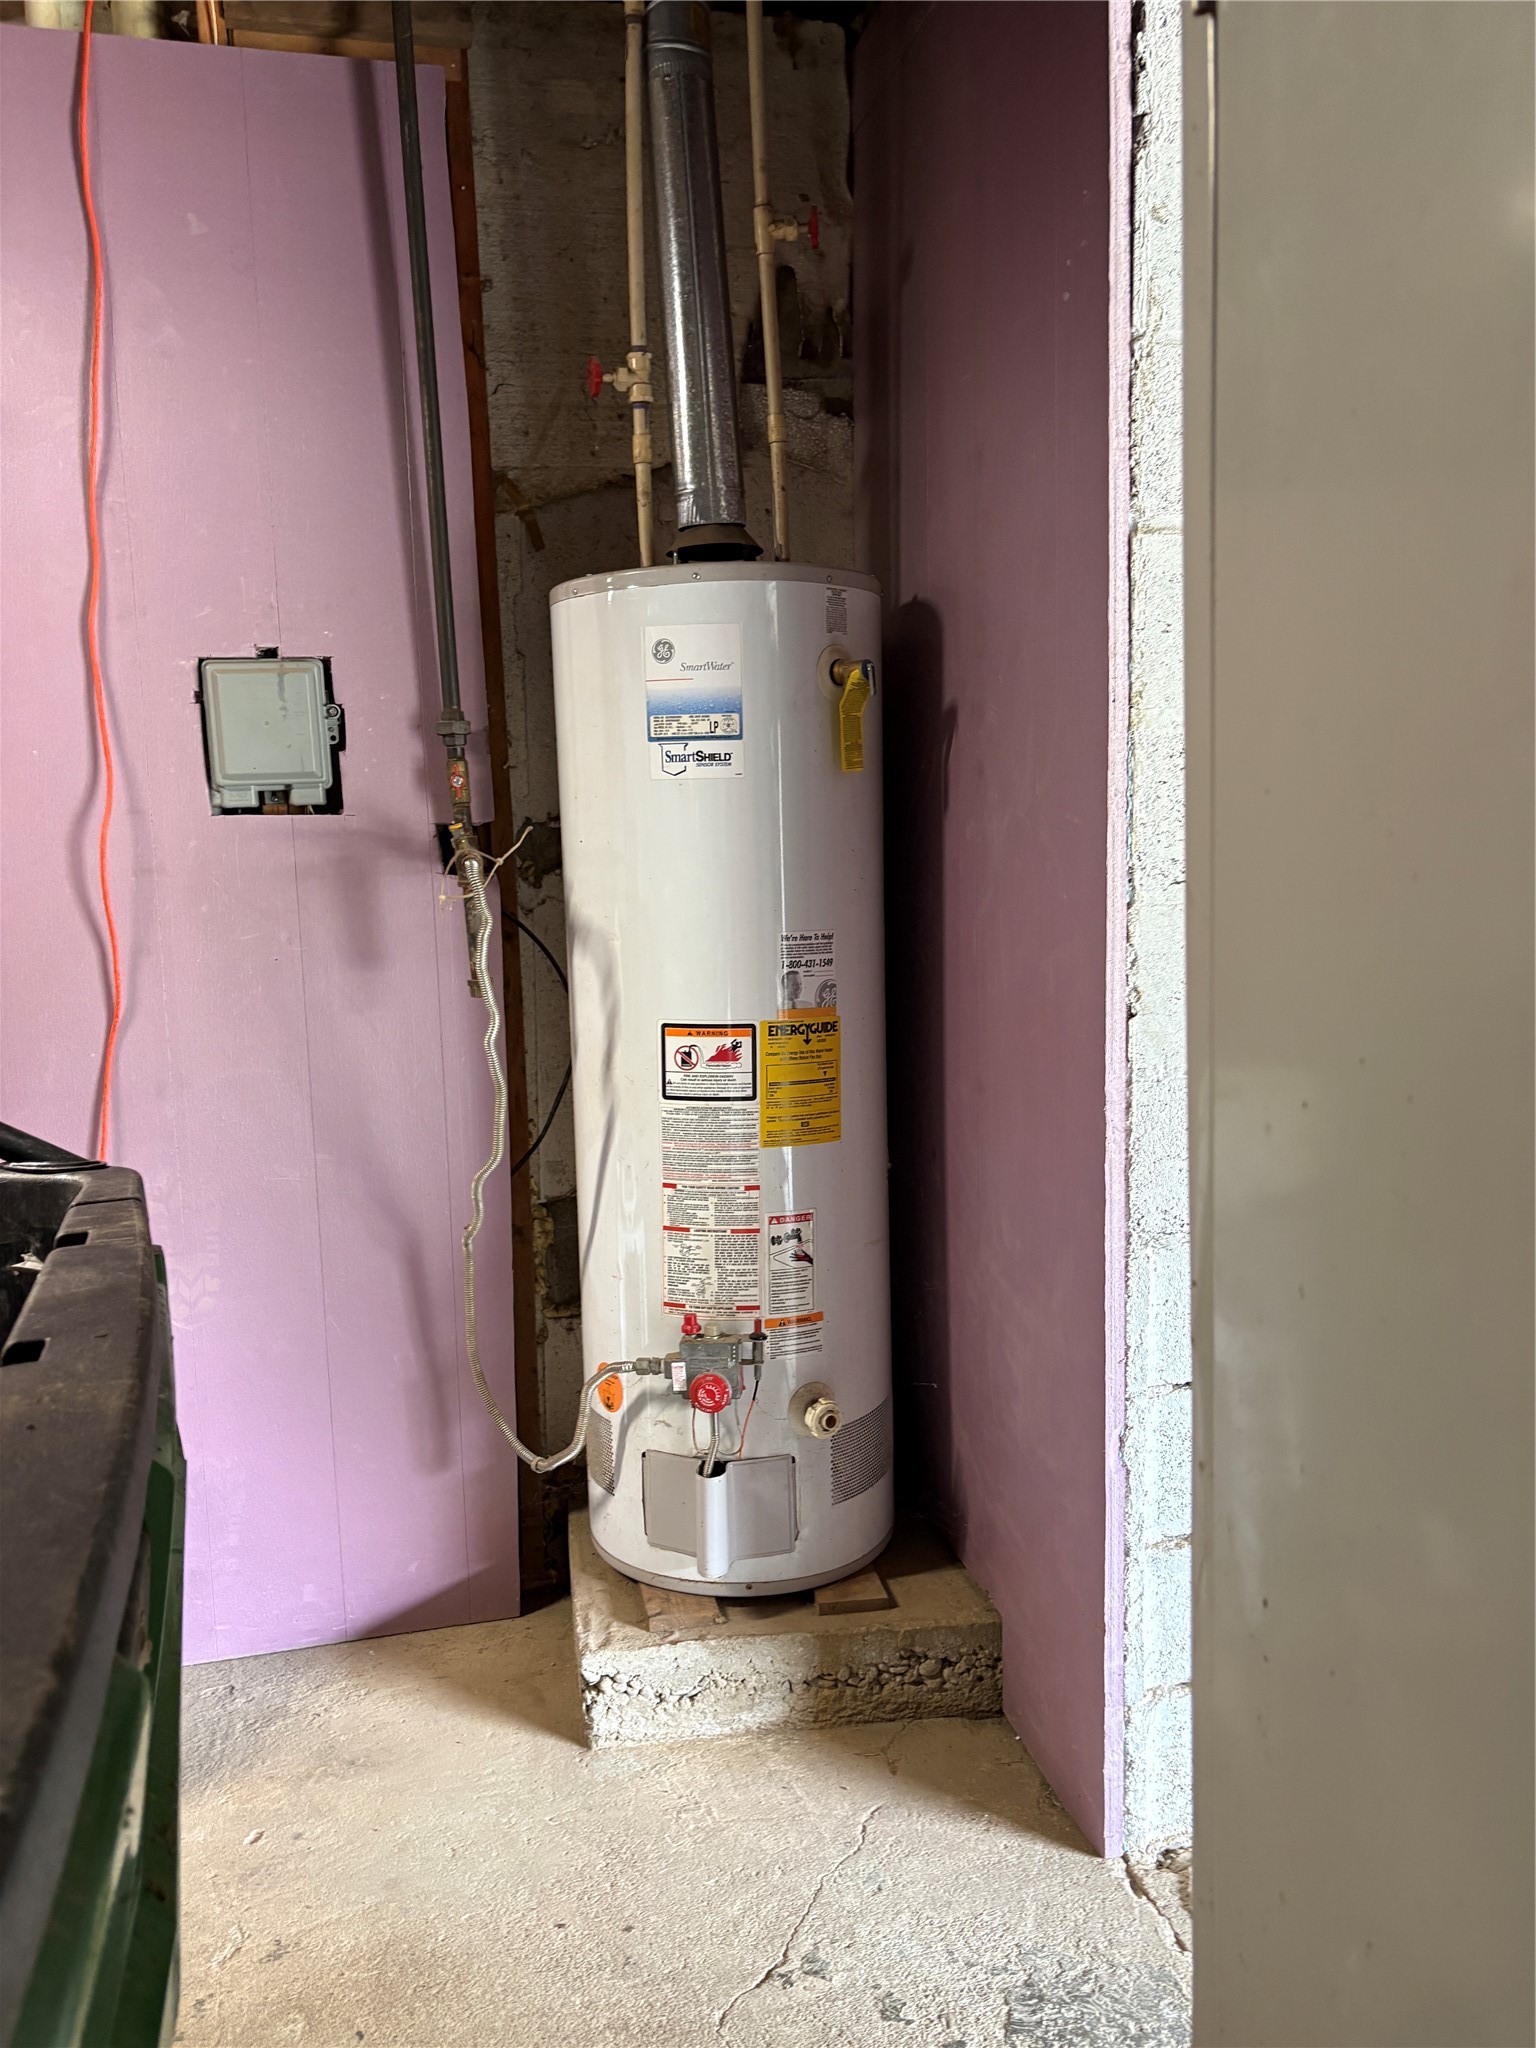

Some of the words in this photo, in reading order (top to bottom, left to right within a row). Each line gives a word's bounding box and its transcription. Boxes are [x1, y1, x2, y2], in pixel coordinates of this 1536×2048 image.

[680, 661, 732, 672] SmartWater
[709, 721, 719, 734] LP
[780, 1214, 812, 1223] DANGER
